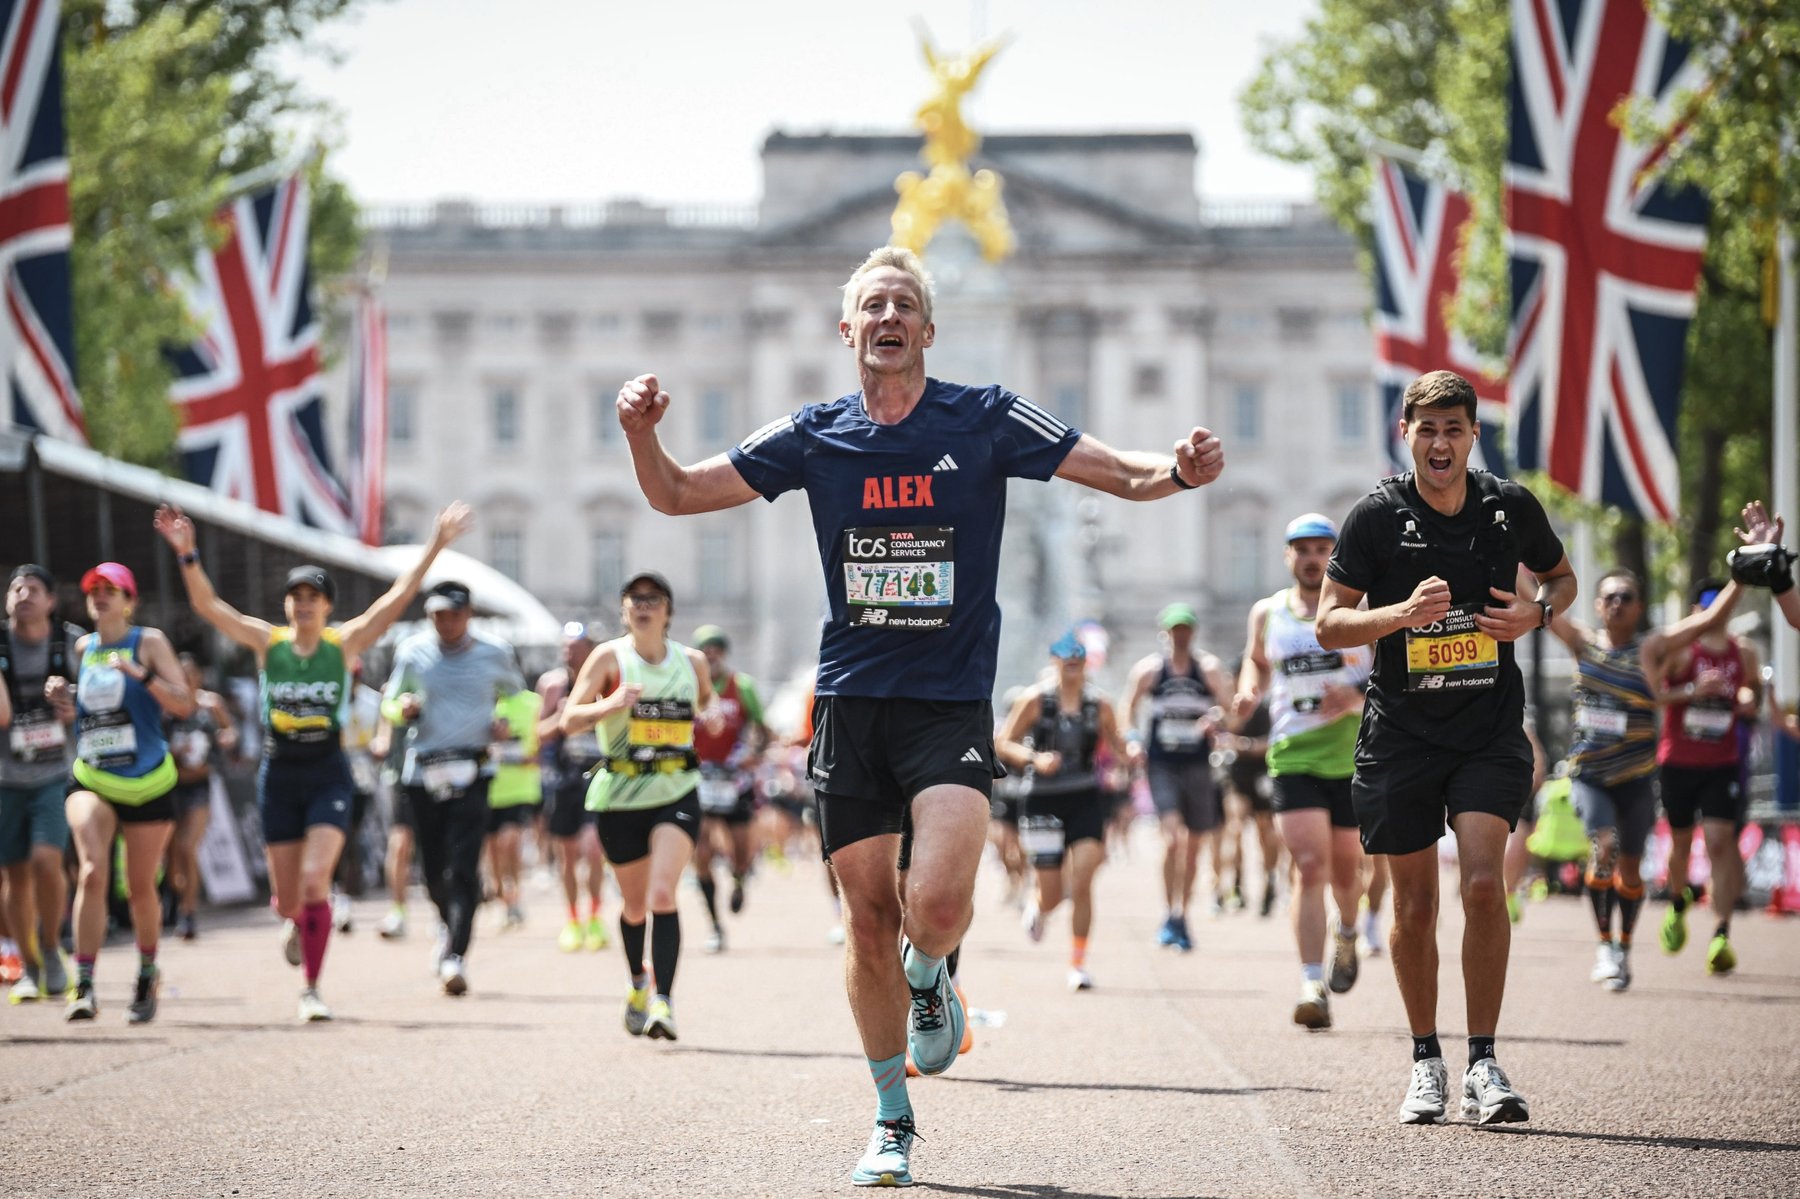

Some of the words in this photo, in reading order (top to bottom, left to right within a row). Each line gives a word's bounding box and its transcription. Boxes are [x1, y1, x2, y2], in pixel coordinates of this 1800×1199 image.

[862, 475, 934, 509] ALEX
[849, 534, 887, 558] tcs
[890, 540, 946, 548] CONSULTANCY
[891, 549, 926, 557] SERVICES
[861, 572, 936, 597] 77148
[1446, 609, 1464, 617] TATA
[888, 617, 907, 626] new
[908, 616, 943, 626] balance
[1446, 622, 1474, 632] SERVICES
[1428, 639, 1477, 665] 5099
[1462, 678, 1494, 686] balance
